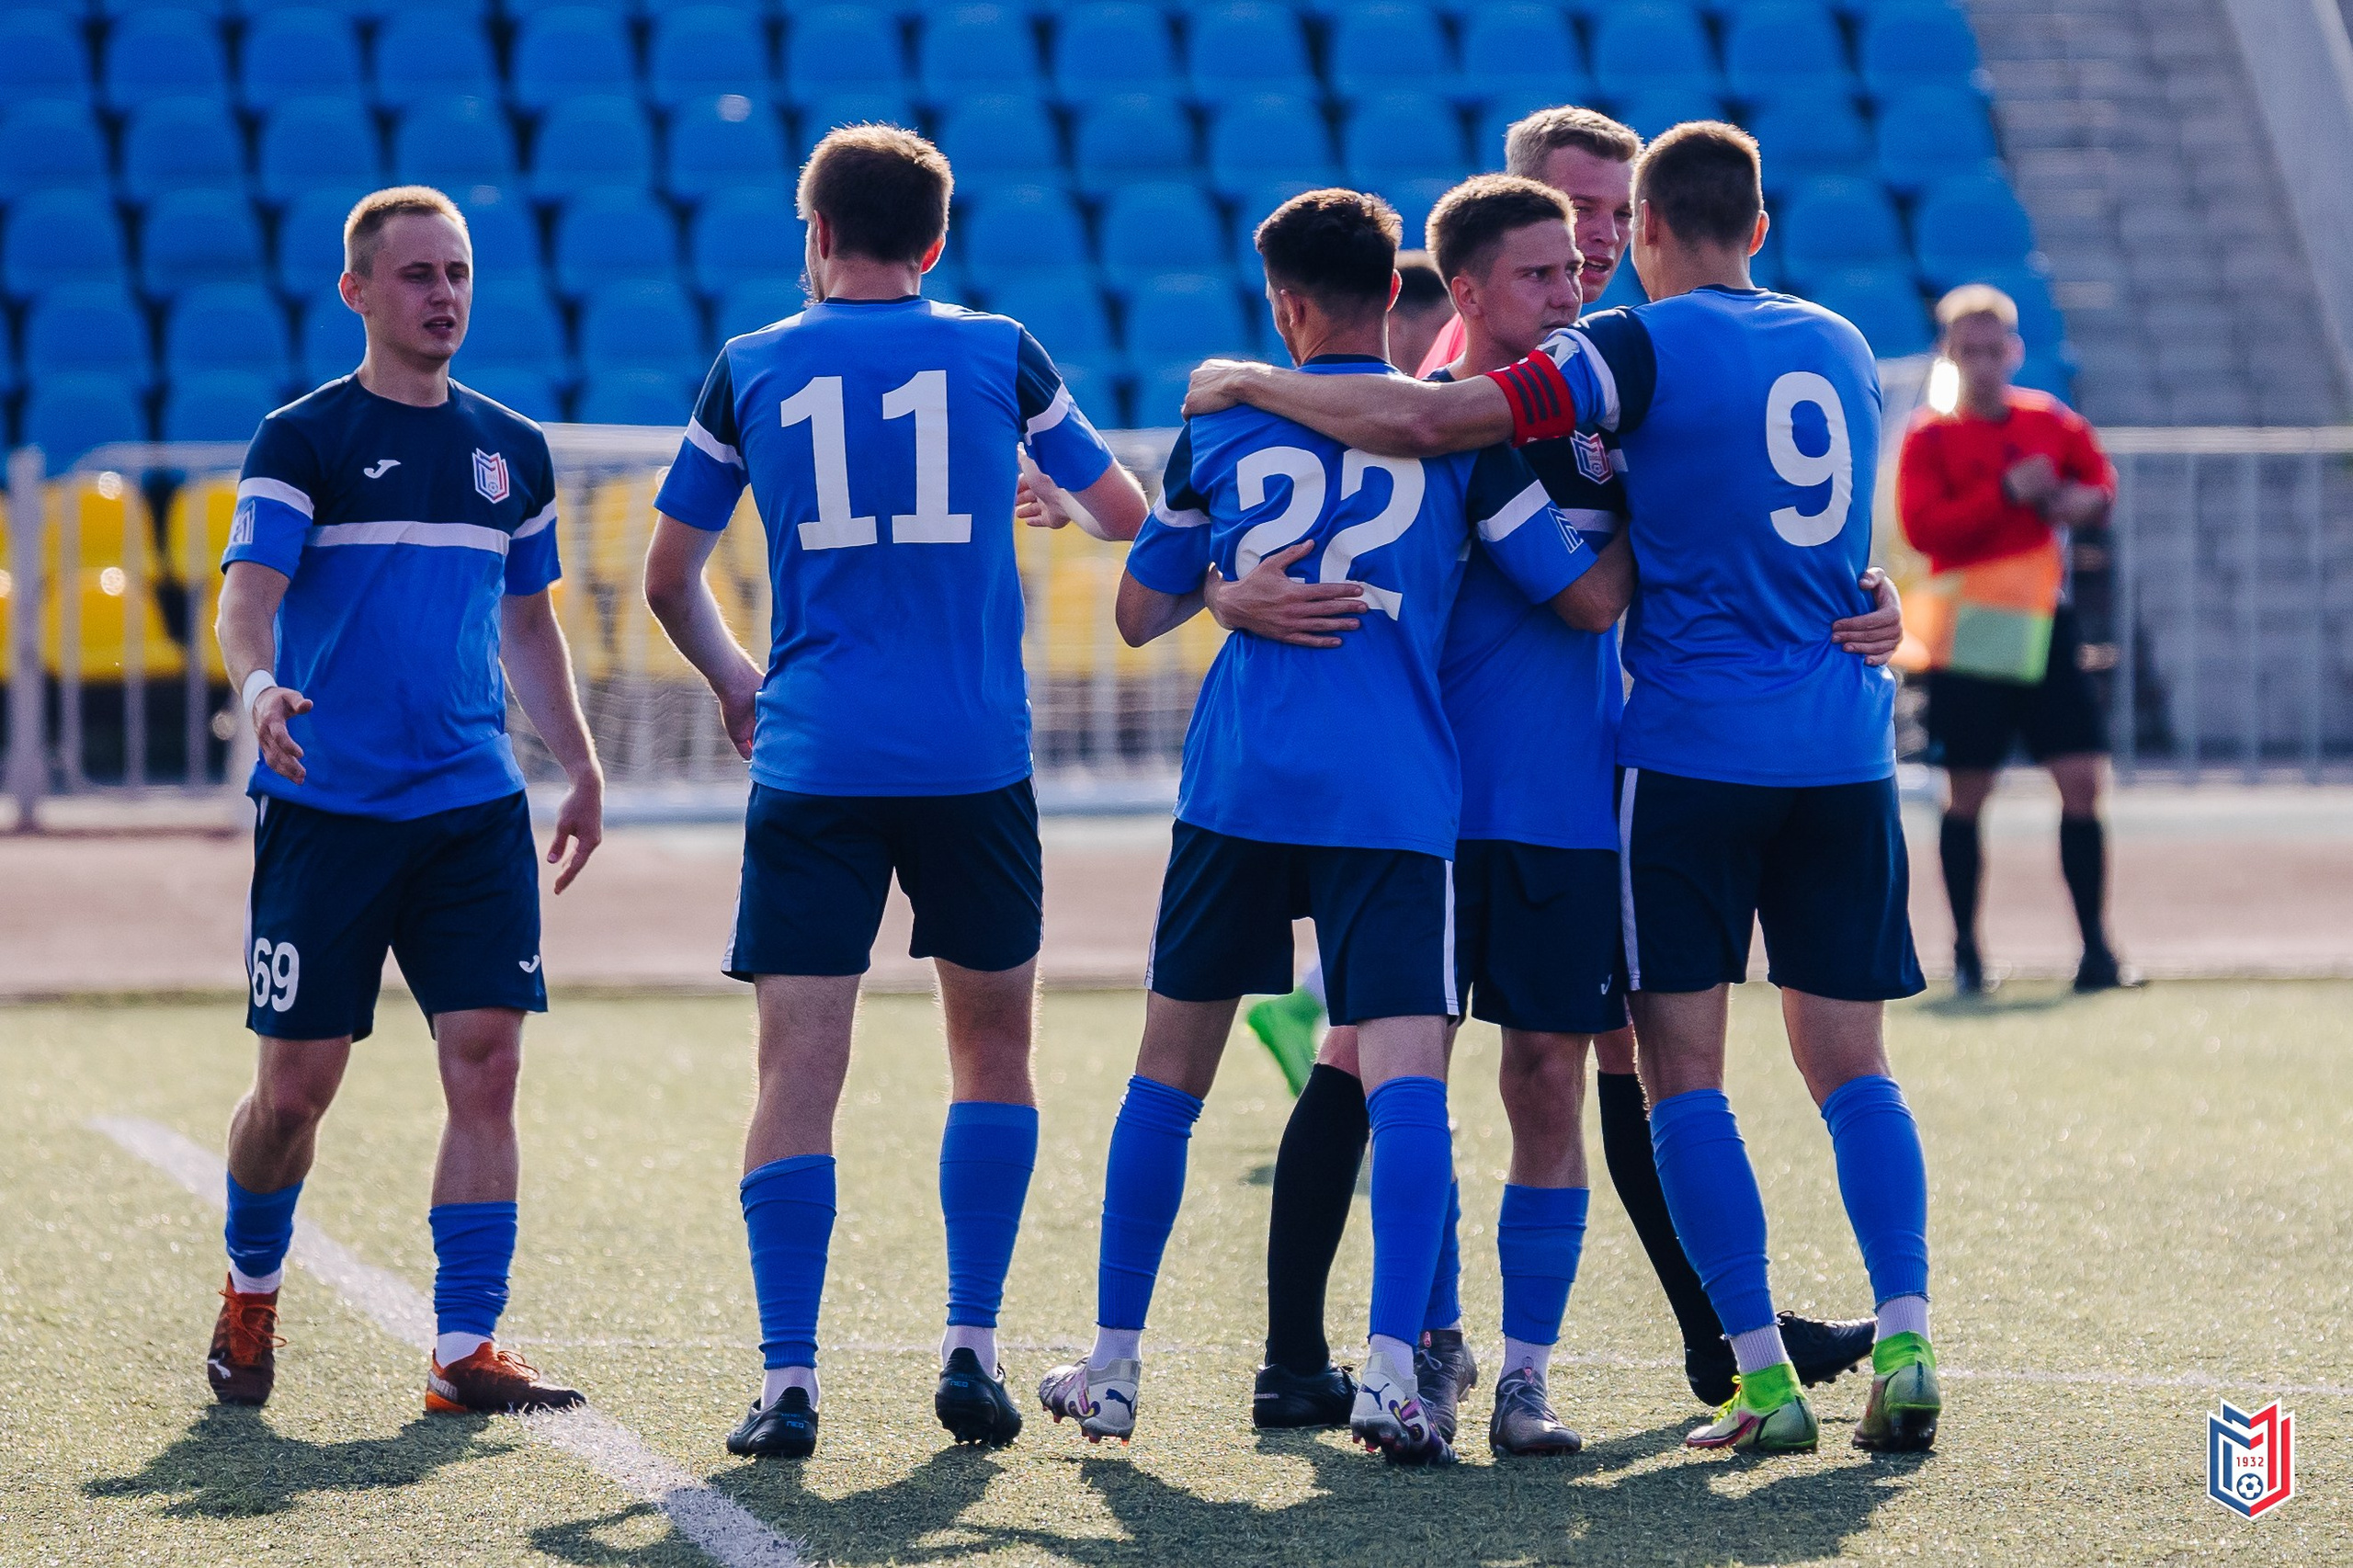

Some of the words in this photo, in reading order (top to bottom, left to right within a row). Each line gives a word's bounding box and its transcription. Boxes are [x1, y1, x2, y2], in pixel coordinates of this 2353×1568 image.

[780, 369, 972, 551] 11
[1235, 446, 1426, 621] 22
[1766, 371, 1853, 547] 9
[252, 937, 300, 1013] 69
